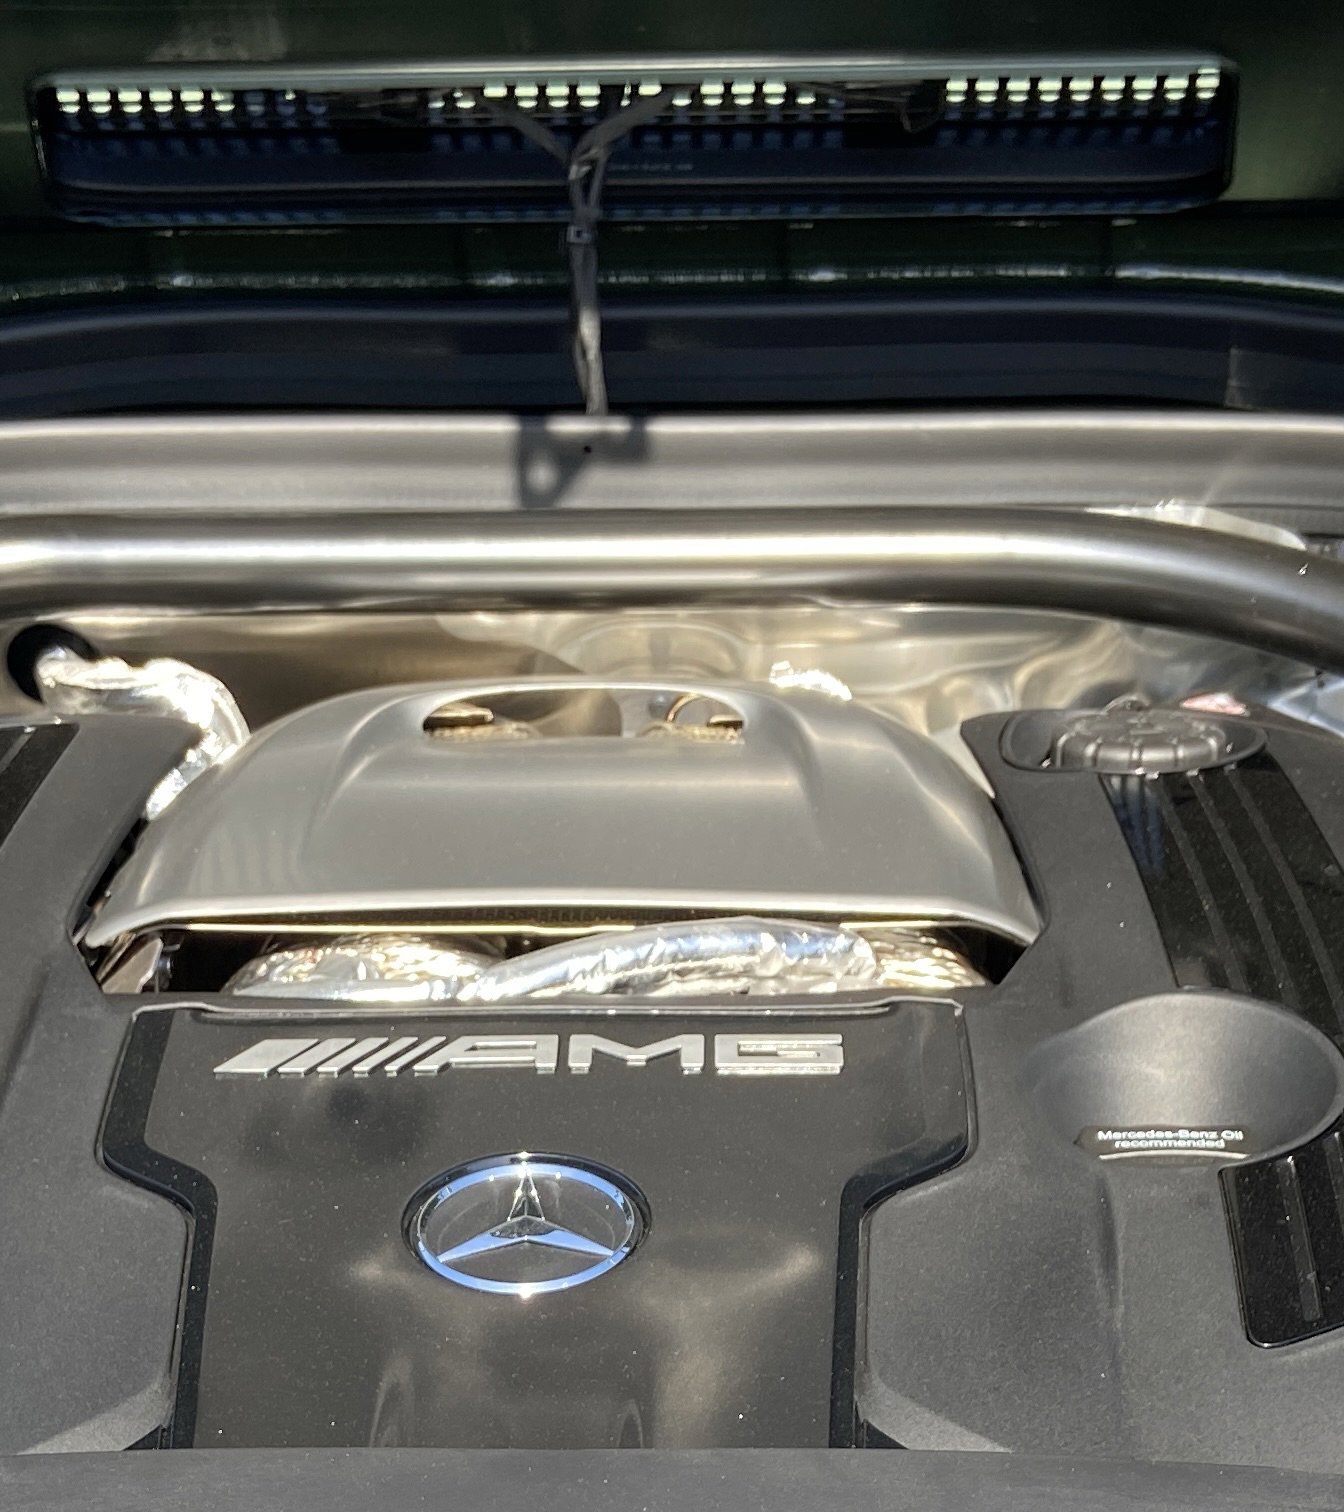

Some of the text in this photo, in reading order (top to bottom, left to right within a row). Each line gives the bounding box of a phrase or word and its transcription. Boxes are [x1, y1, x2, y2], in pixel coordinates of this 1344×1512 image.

[413, 1033, 844, 1075] AMG
[1097, 1129, 1245, 1141] Mercedes-Benz Oil
[1114, 1139, 1226, 1149] recommended
